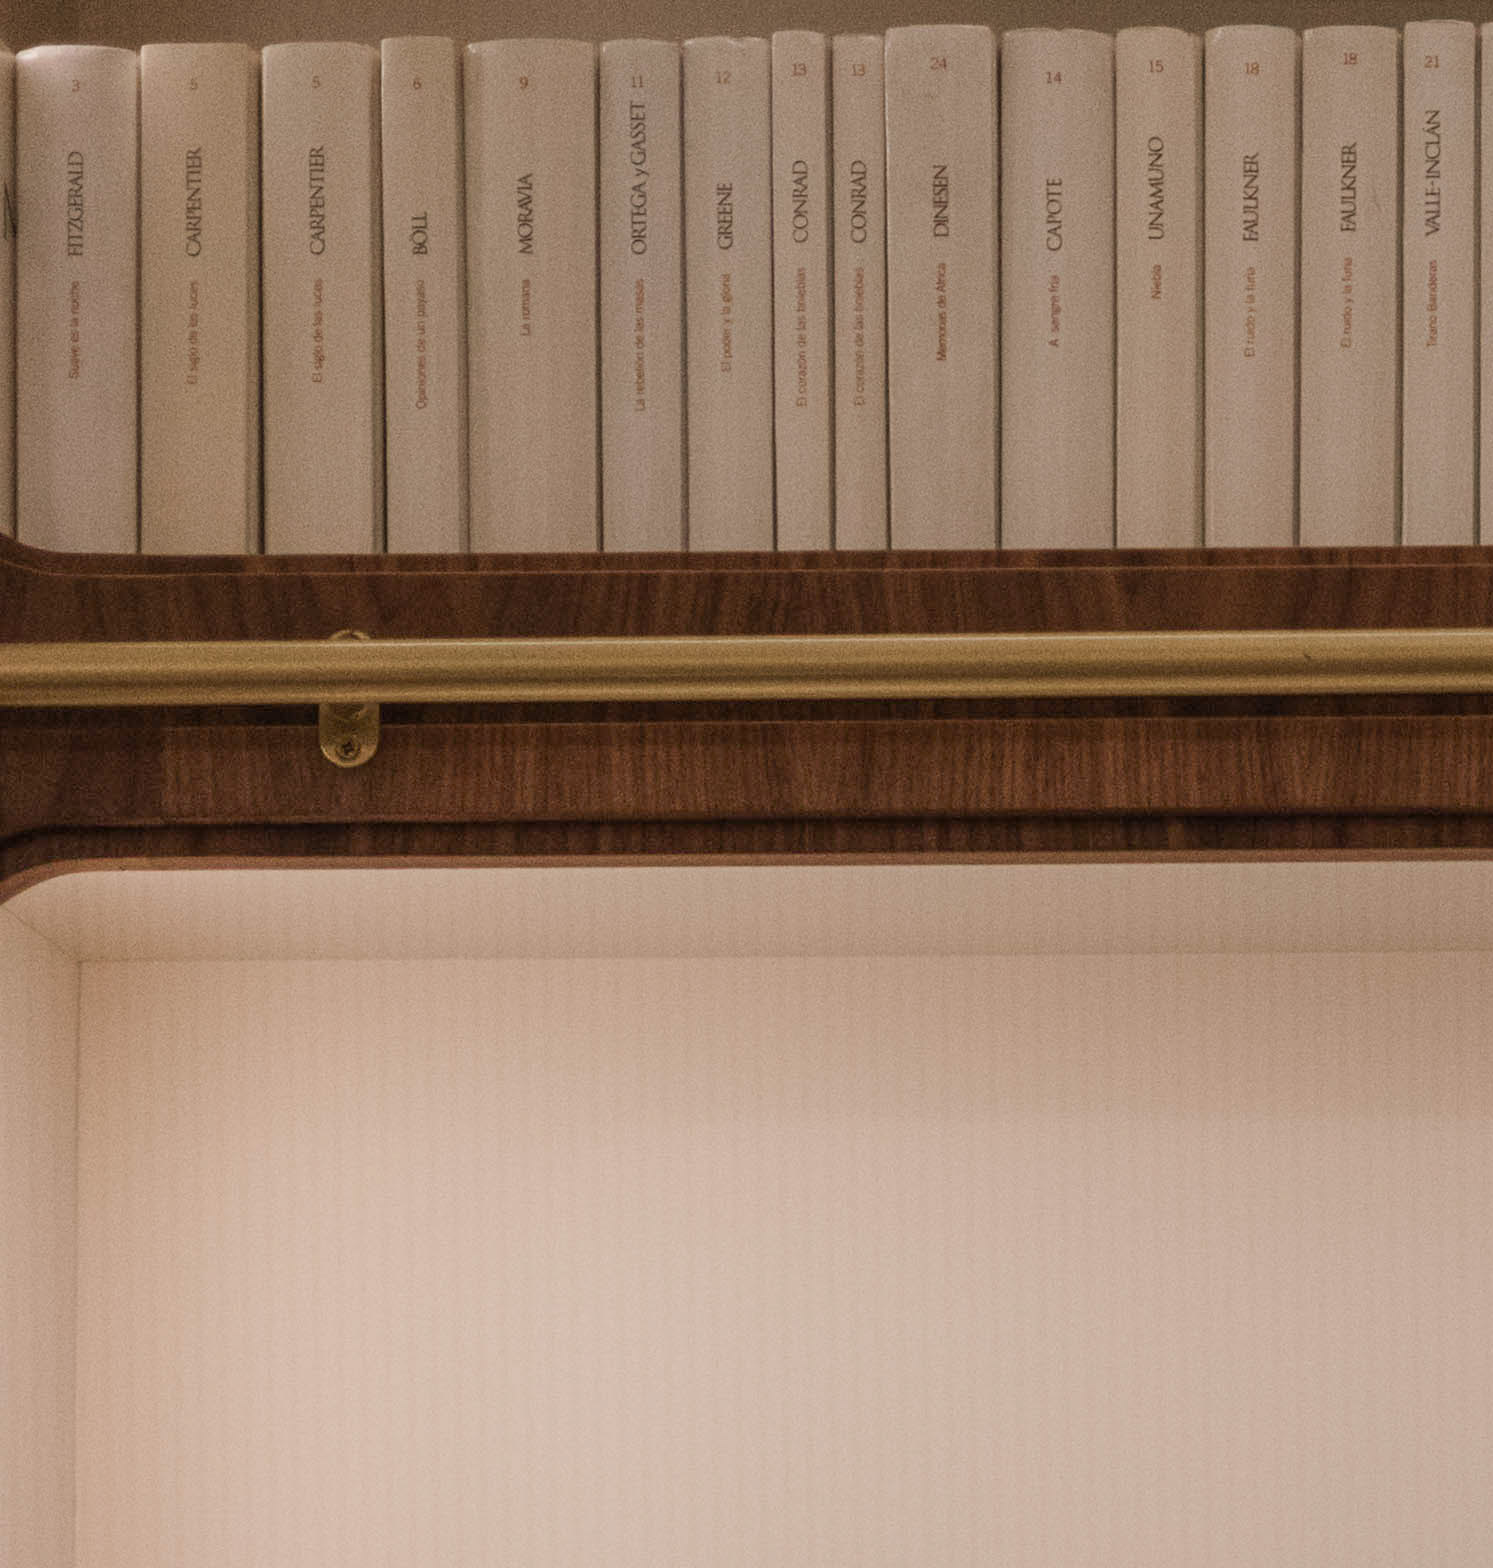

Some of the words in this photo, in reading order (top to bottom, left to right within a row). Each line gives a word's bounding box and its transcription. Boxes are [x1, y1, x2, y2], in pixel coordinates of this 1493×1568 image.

[67, 150, 84, 258] FITZGERALD
[517, 172, 536, 255] MORAVIA
[791, 159, 810, 244] CONRAD
[933, 163, 950, 238] DINESEN
[1147, 135, 1166, 241] UNAMUNO
